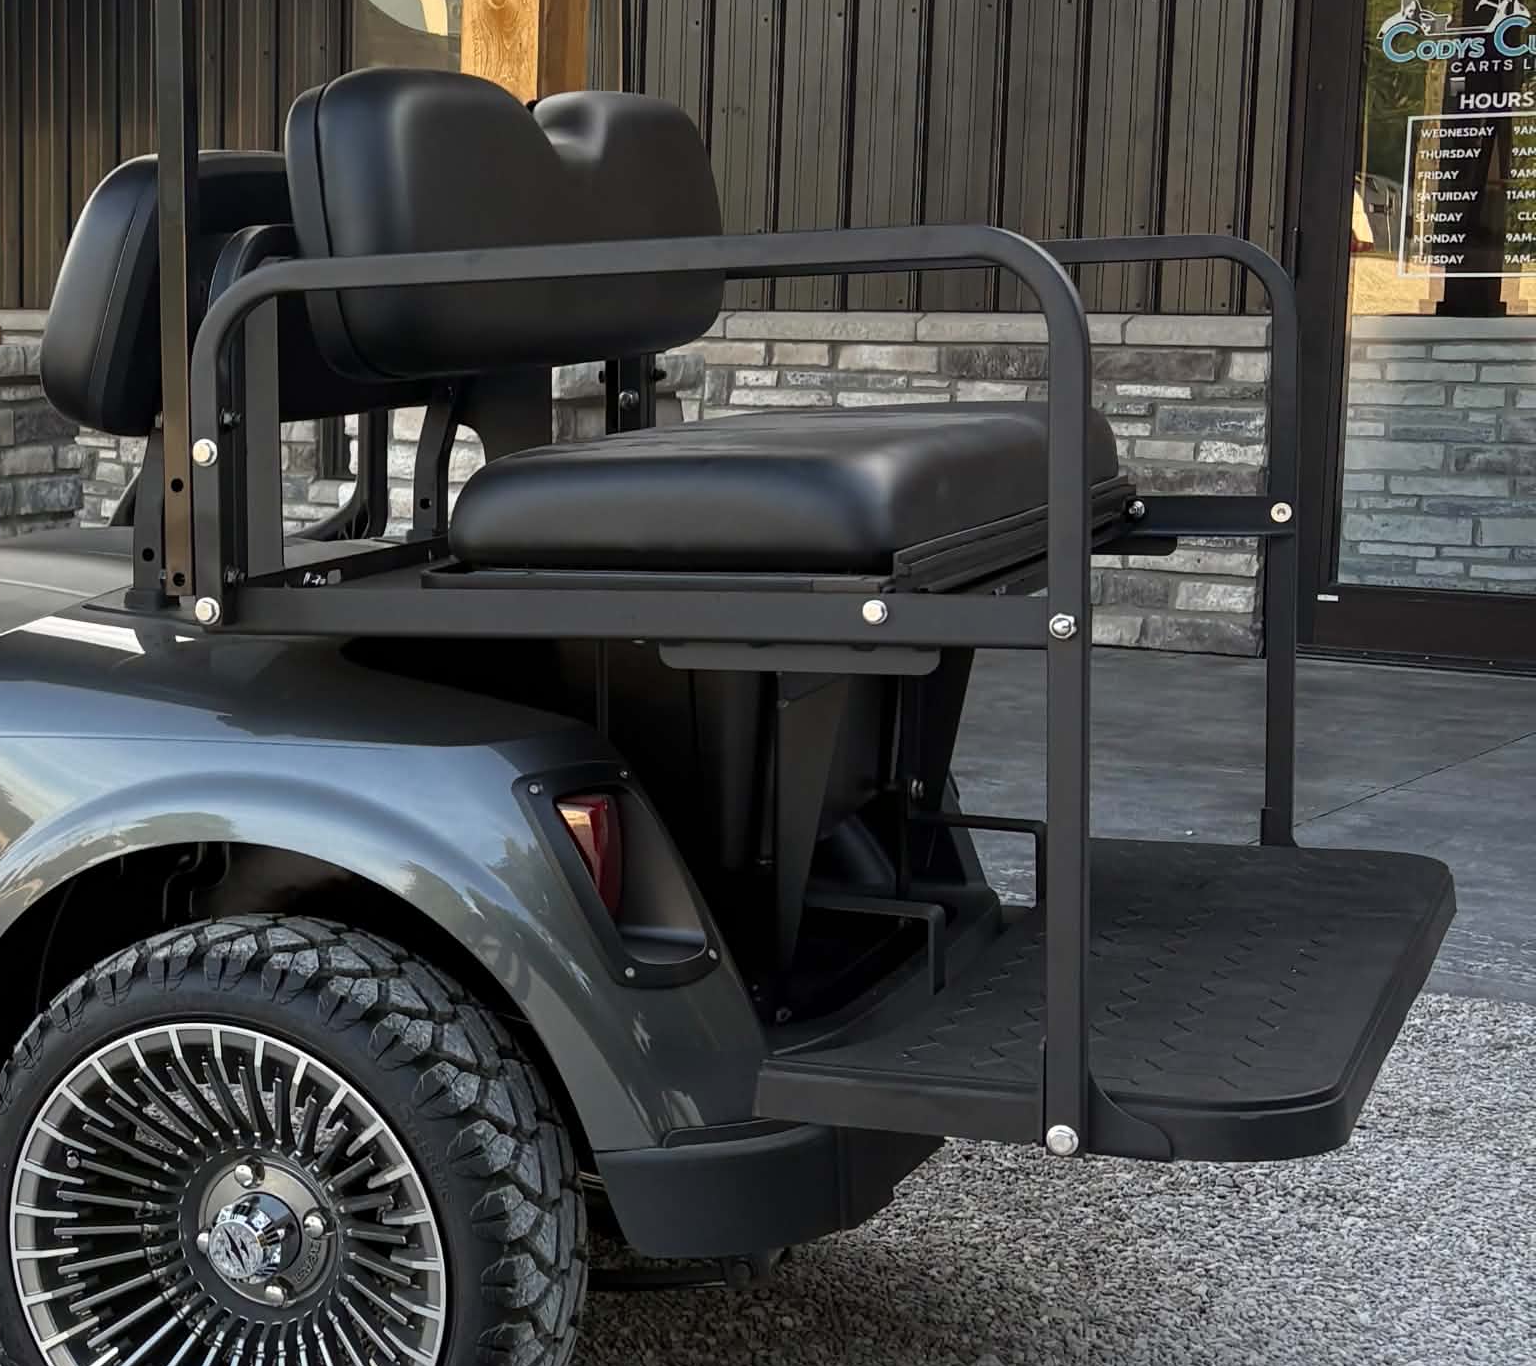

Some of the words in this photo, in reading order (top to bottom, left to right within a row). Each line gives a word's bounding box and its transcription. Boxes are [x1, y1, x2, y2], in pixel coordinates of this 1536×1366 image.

[1450, 59, 1513, 73] CARTS
[1459, 91, 1535, 110] HOURS
[1421, 126, 1495, 138] WEDNESDAY
[1419, 148, 1481, 159] THURSDAY
[1417, 170, 1459, 180] FRIDAY
[1416, 191, 1478, 201] SATURDAY
[1415, 213, 1463, 223] SUNDAY
[1413, 234, 1466, 244] MONDAY
[1412, 255, 1464, 265] TUESDAY
